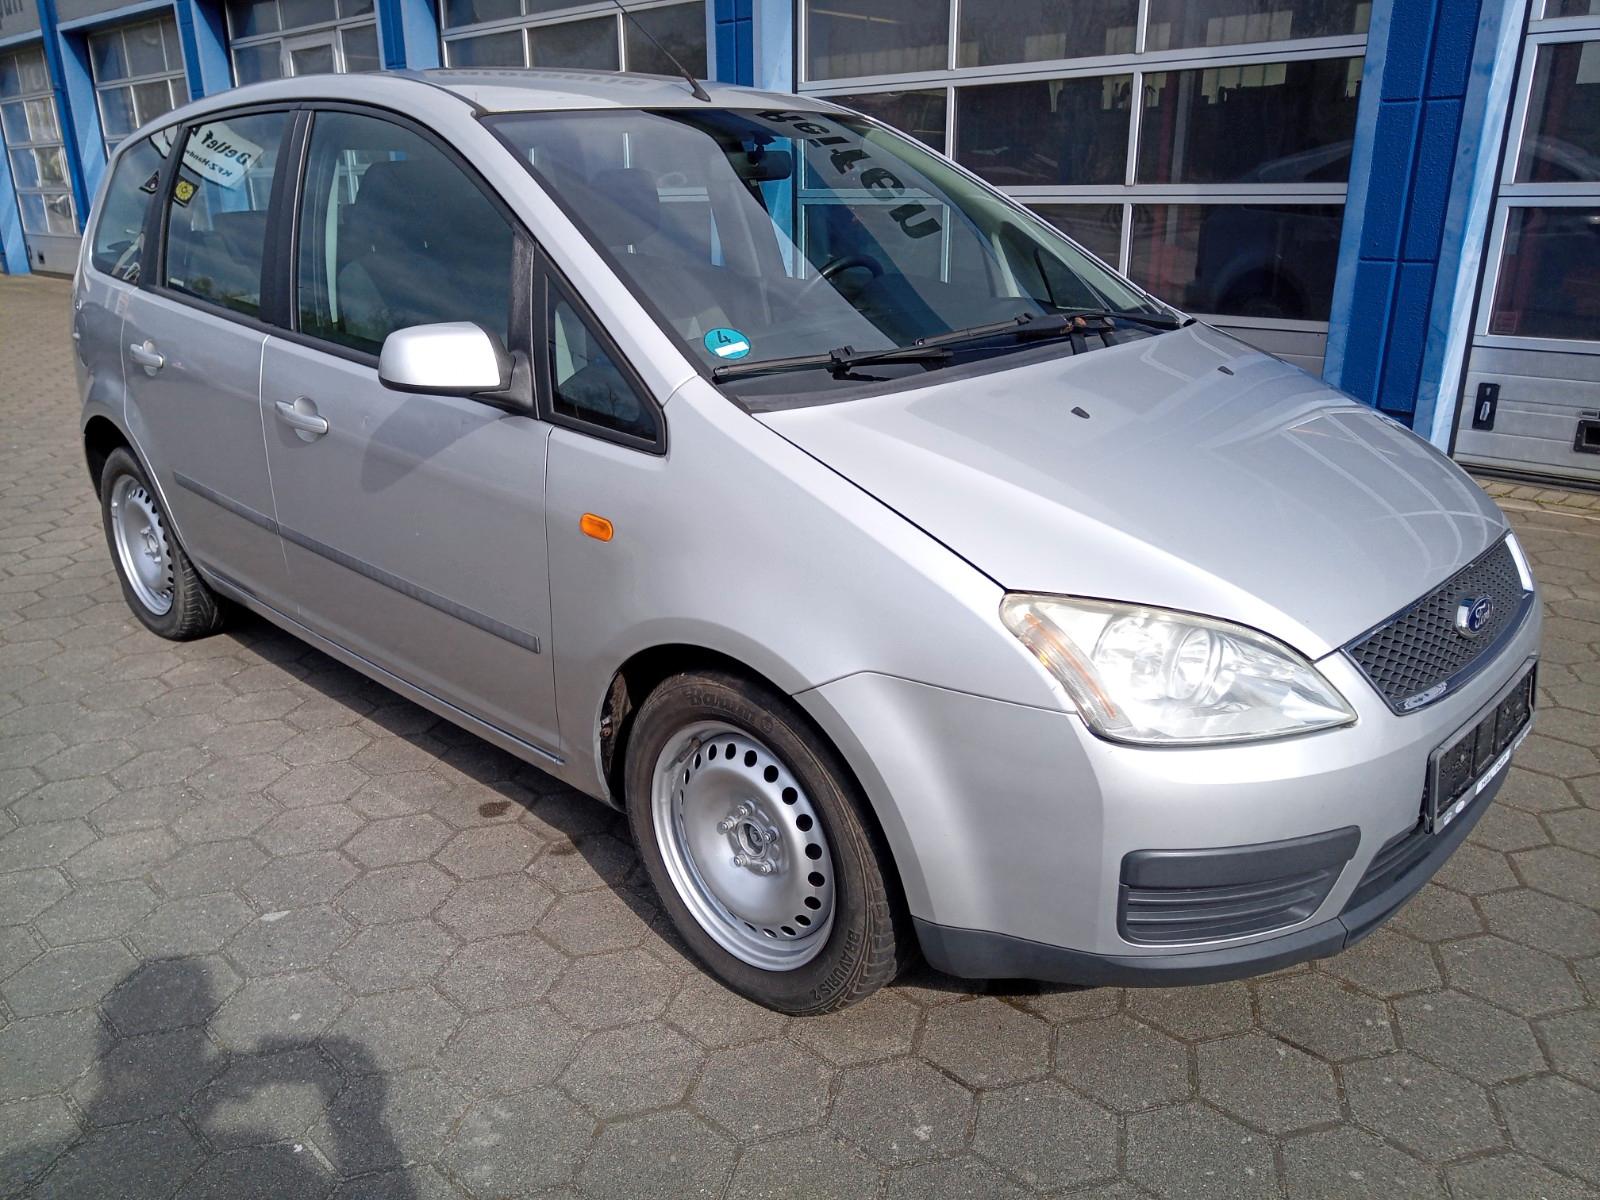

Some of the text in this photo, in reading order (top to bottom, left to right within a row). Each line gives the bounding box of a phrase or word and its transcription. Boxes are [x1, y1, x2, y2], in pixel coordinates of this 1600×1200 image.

[715, 330, 732, 344] 4
[1473, 601, 1490, 630] Ford
[809, 928, 861, 1000] BRAVURIS 2
